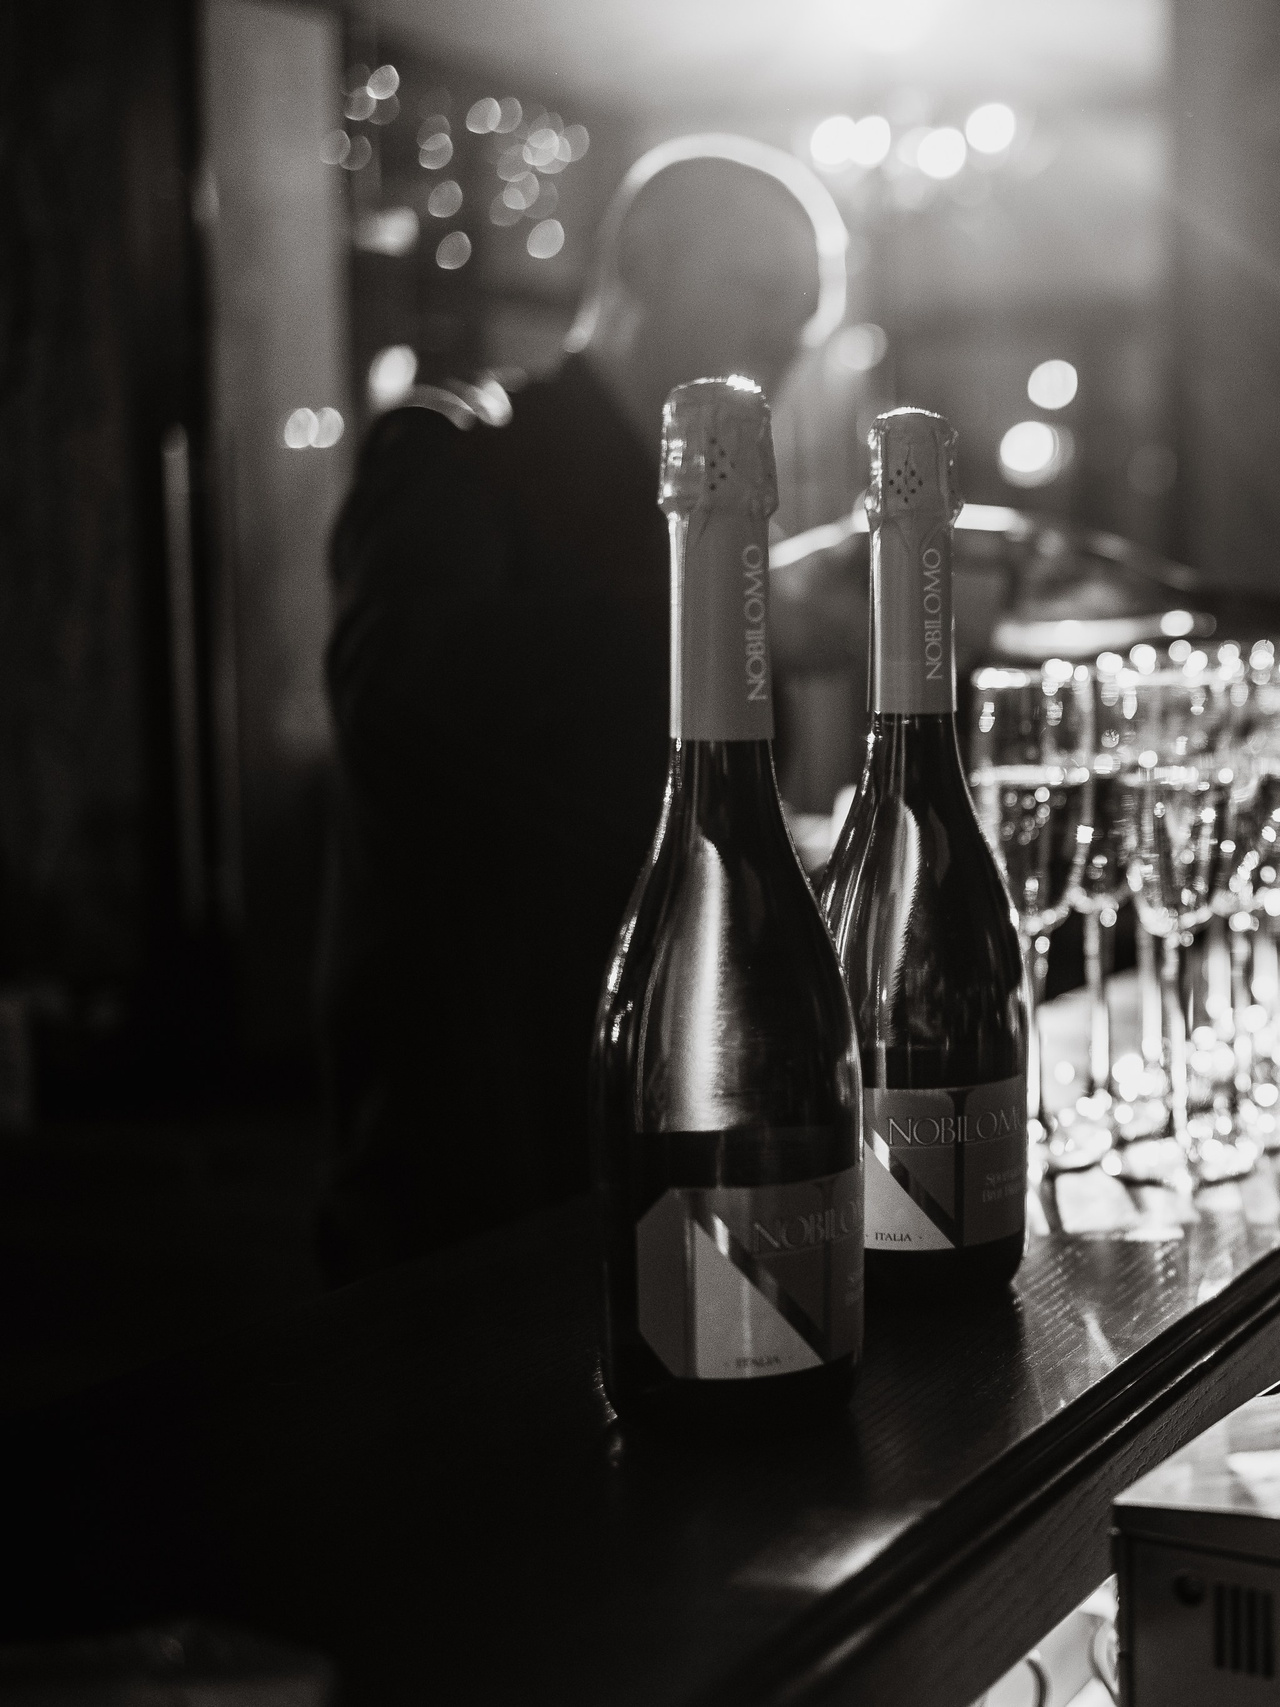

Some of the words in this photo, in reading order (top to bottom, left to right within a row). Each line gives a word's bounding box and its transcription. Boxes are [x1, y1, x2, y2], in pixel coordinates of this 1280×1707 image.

[742, 545, 769, 701] NOBILOMO
[922, 548, 944, 681] NOBILOMO
[752, 1198, 863, 1250] NOBILO
[874, 1232, 912, 1243] ITALIA
